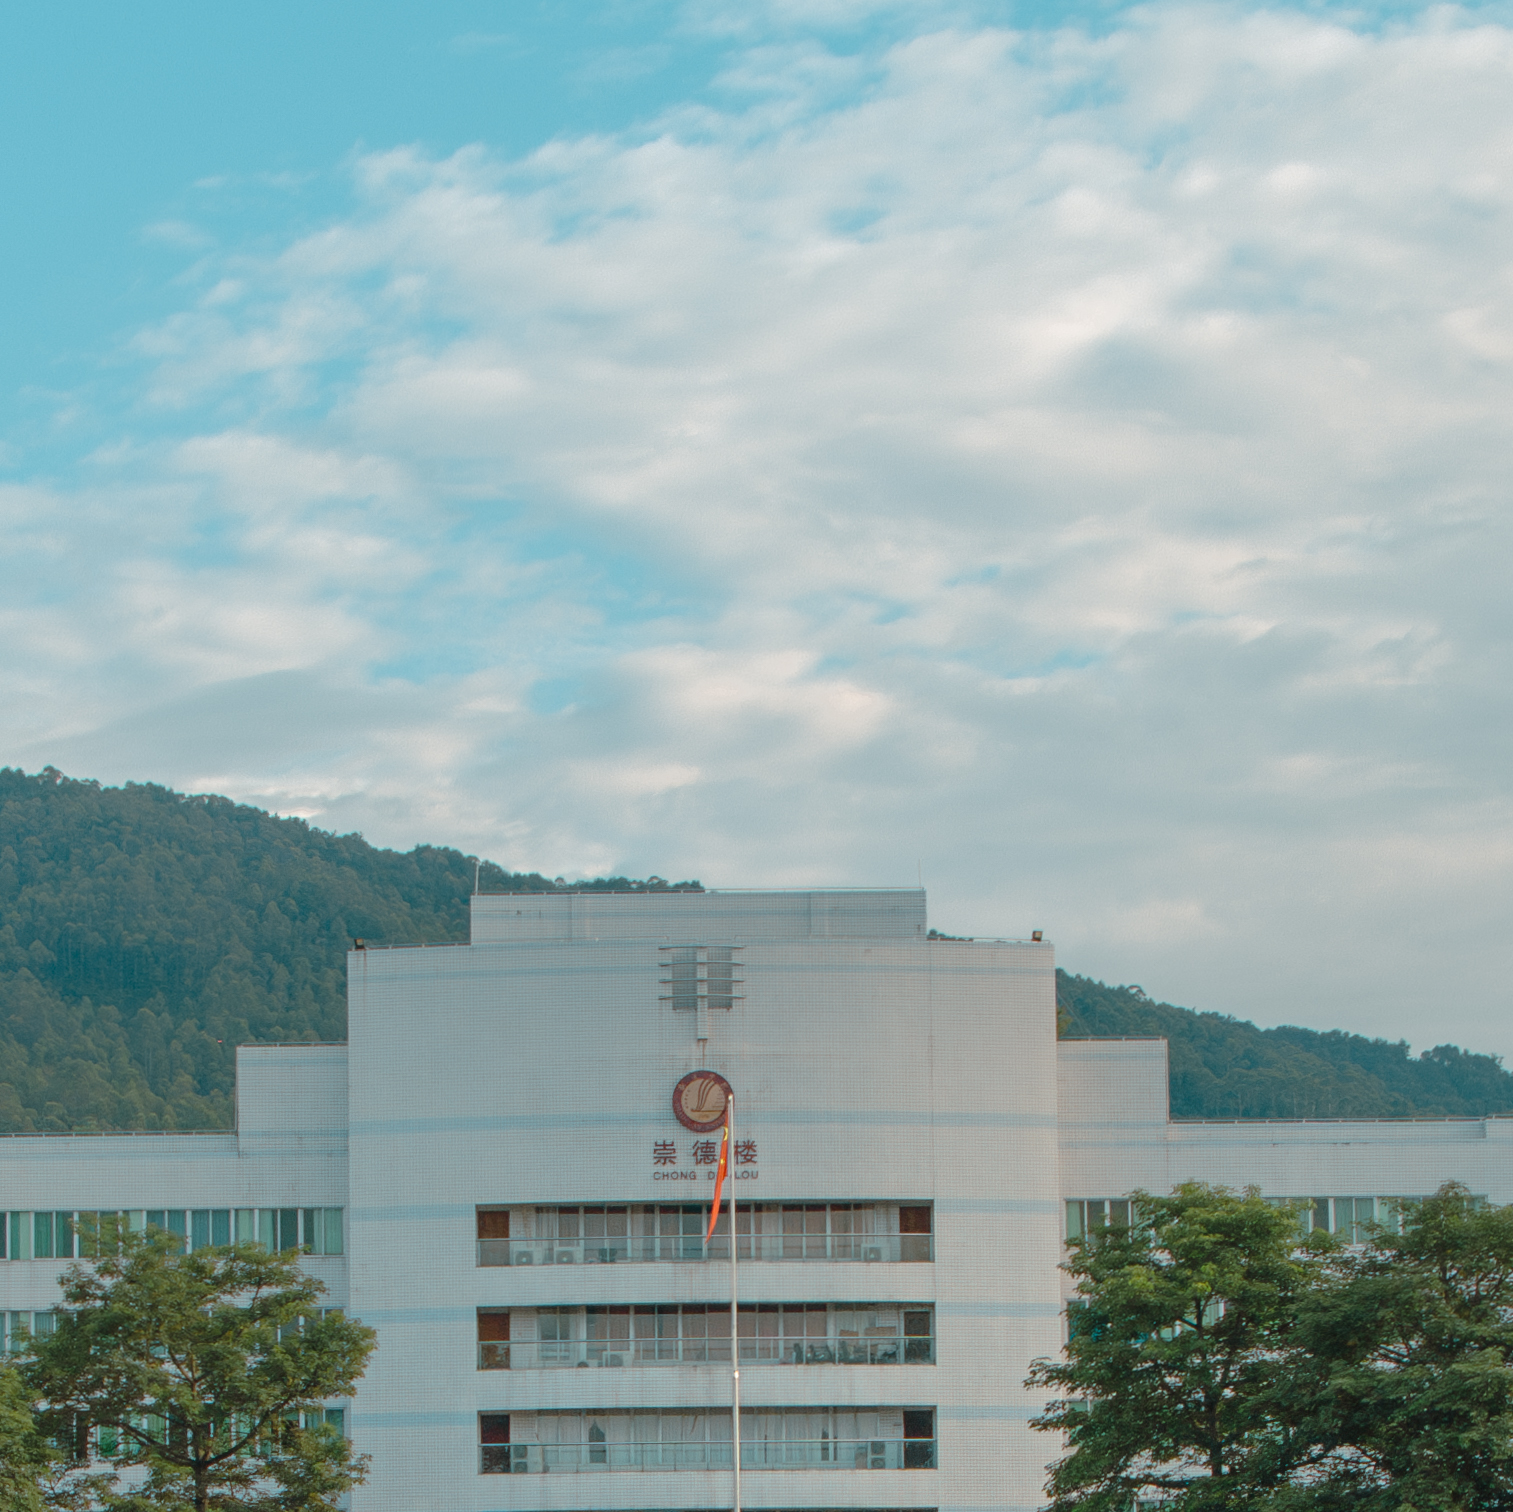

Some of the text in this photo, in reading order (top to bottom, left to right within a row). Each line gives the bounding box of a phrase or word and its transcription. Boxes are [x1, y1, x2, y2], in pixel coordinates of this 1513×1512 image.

[653, 1140, 758, 1166] 崇德楼
[653, 1171, 697, 1181] CHONG
